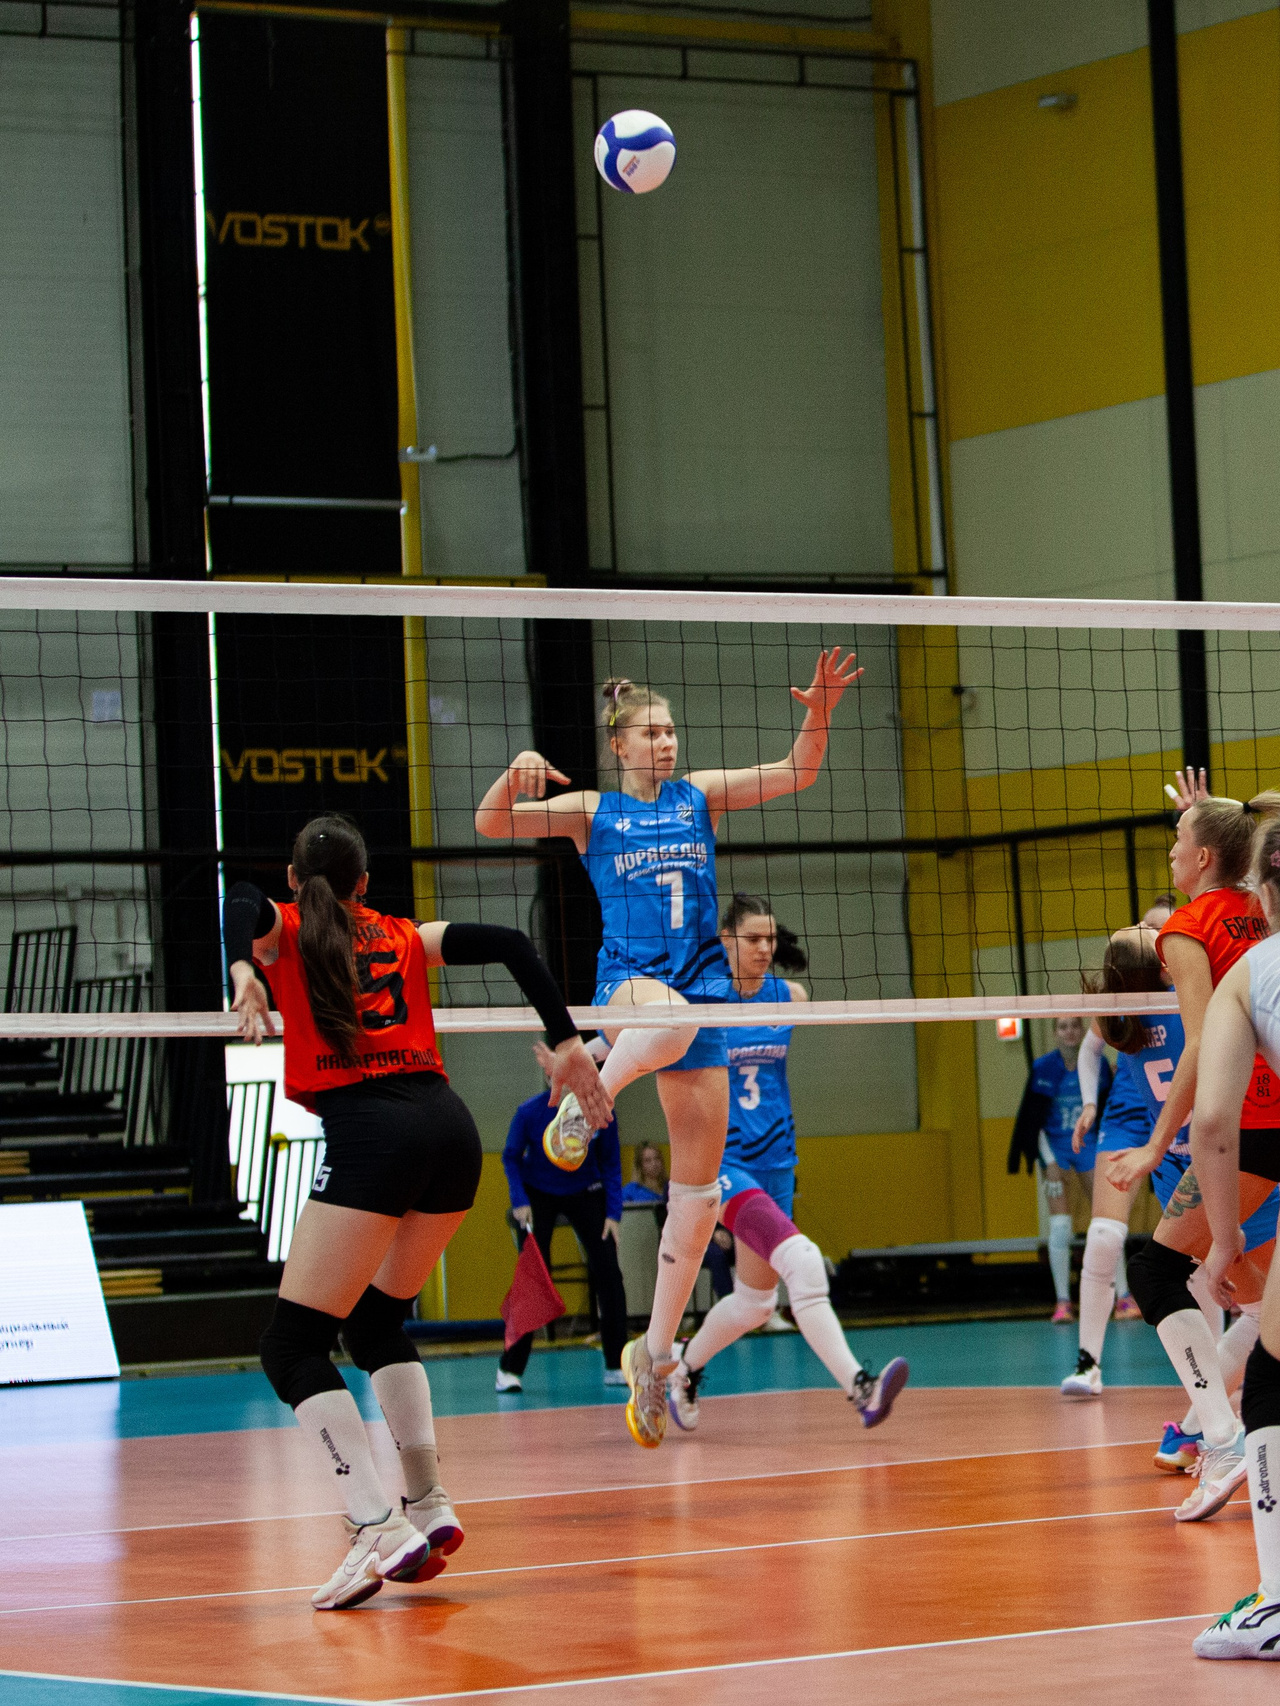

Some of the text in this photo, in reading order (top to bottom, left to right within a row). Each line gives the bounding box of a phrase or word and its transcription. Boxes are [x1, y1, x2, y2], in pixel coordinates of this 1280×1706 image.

[206, 210, 370, 251] VOSTOK
[220, 748, 388, 782] VOSTOK
[655, 870, 684, 930] 1
[356, 950, 408, 1029] 5
[738, 1065, 761, 1110] 3
[1256, 1073, 1270, 1085] 18
[1256, 1086, 1271, 1097] 81
